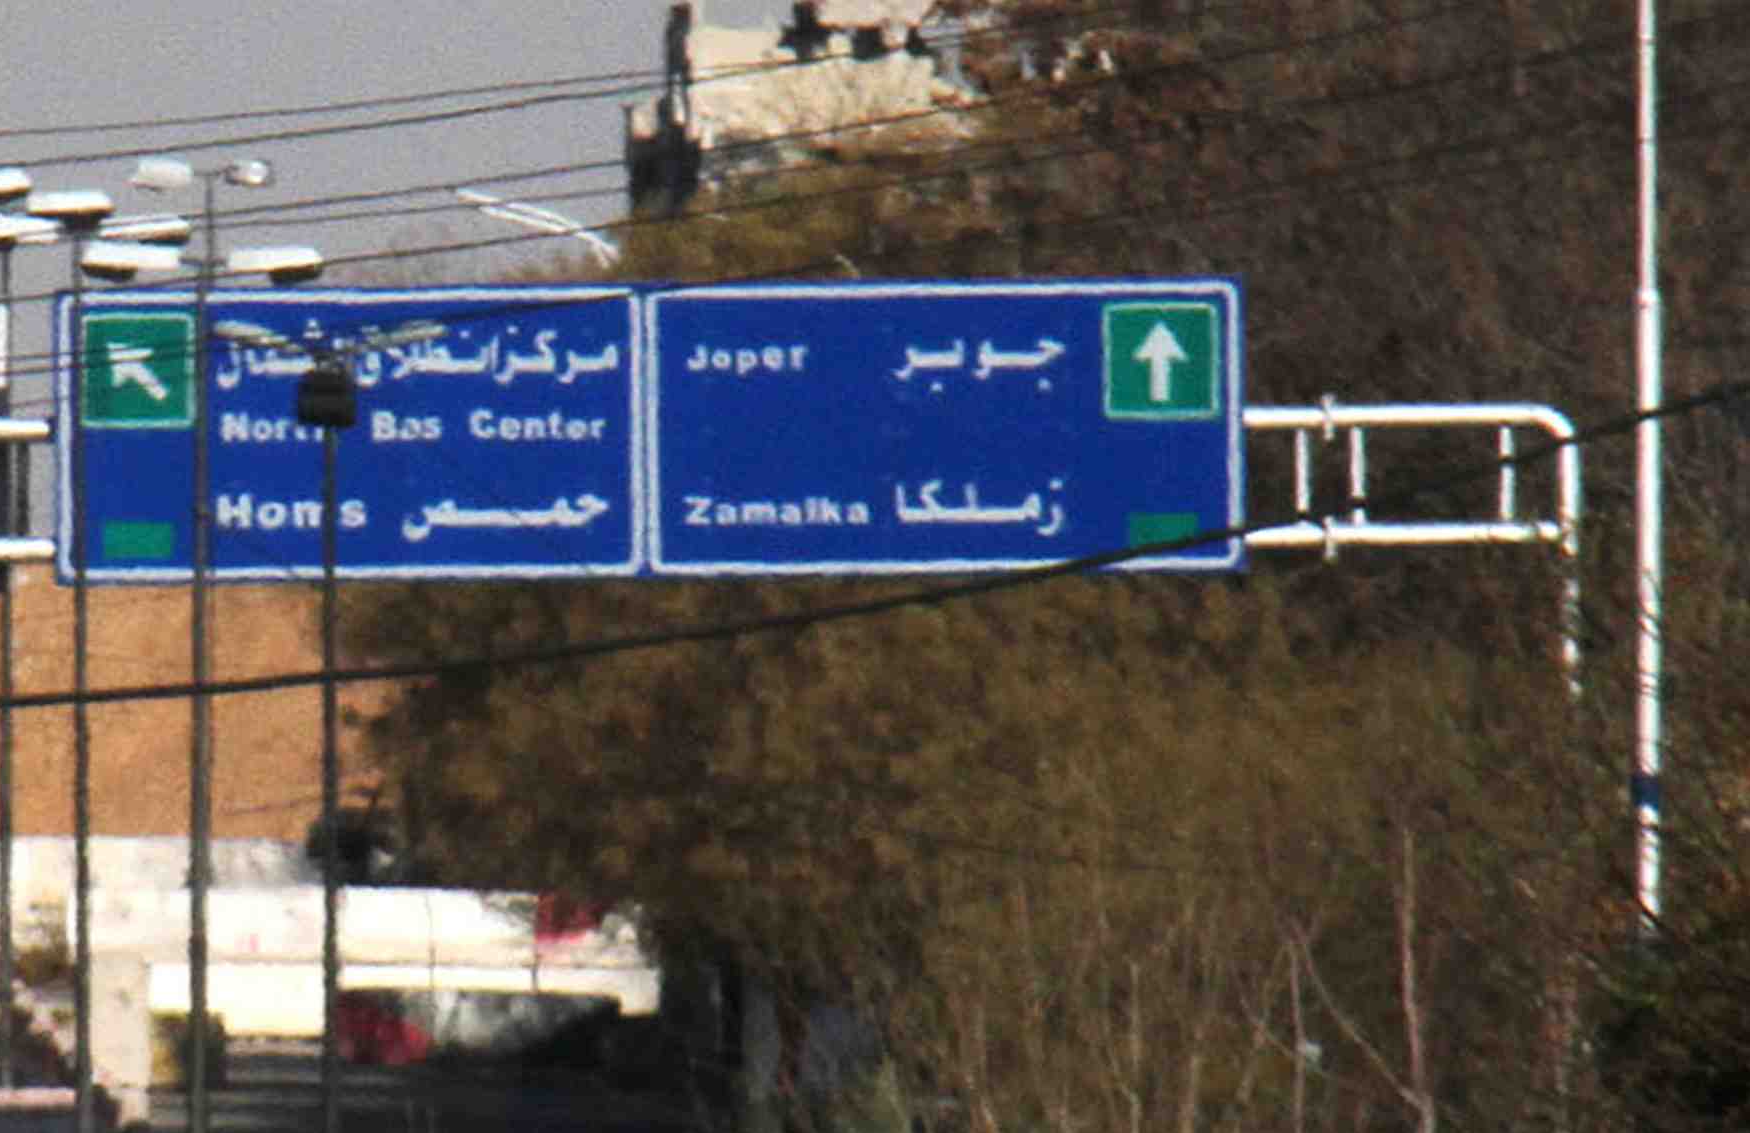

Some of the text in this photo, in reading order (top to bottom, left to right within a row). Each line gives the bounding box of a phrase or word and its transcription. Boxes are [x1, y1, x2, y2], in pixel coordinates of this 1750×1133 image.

[493, 327, 618, 384] مركز
[687, 344, 808, 377] Joper
[894, 337, 1066, 392] جوبر
[468, 407, 606, 441] Center
[400, 493, 611, 542] حمص
[683, 495, 871, 525] Zamalka
[894, 478, 1065, 536] زملكا
